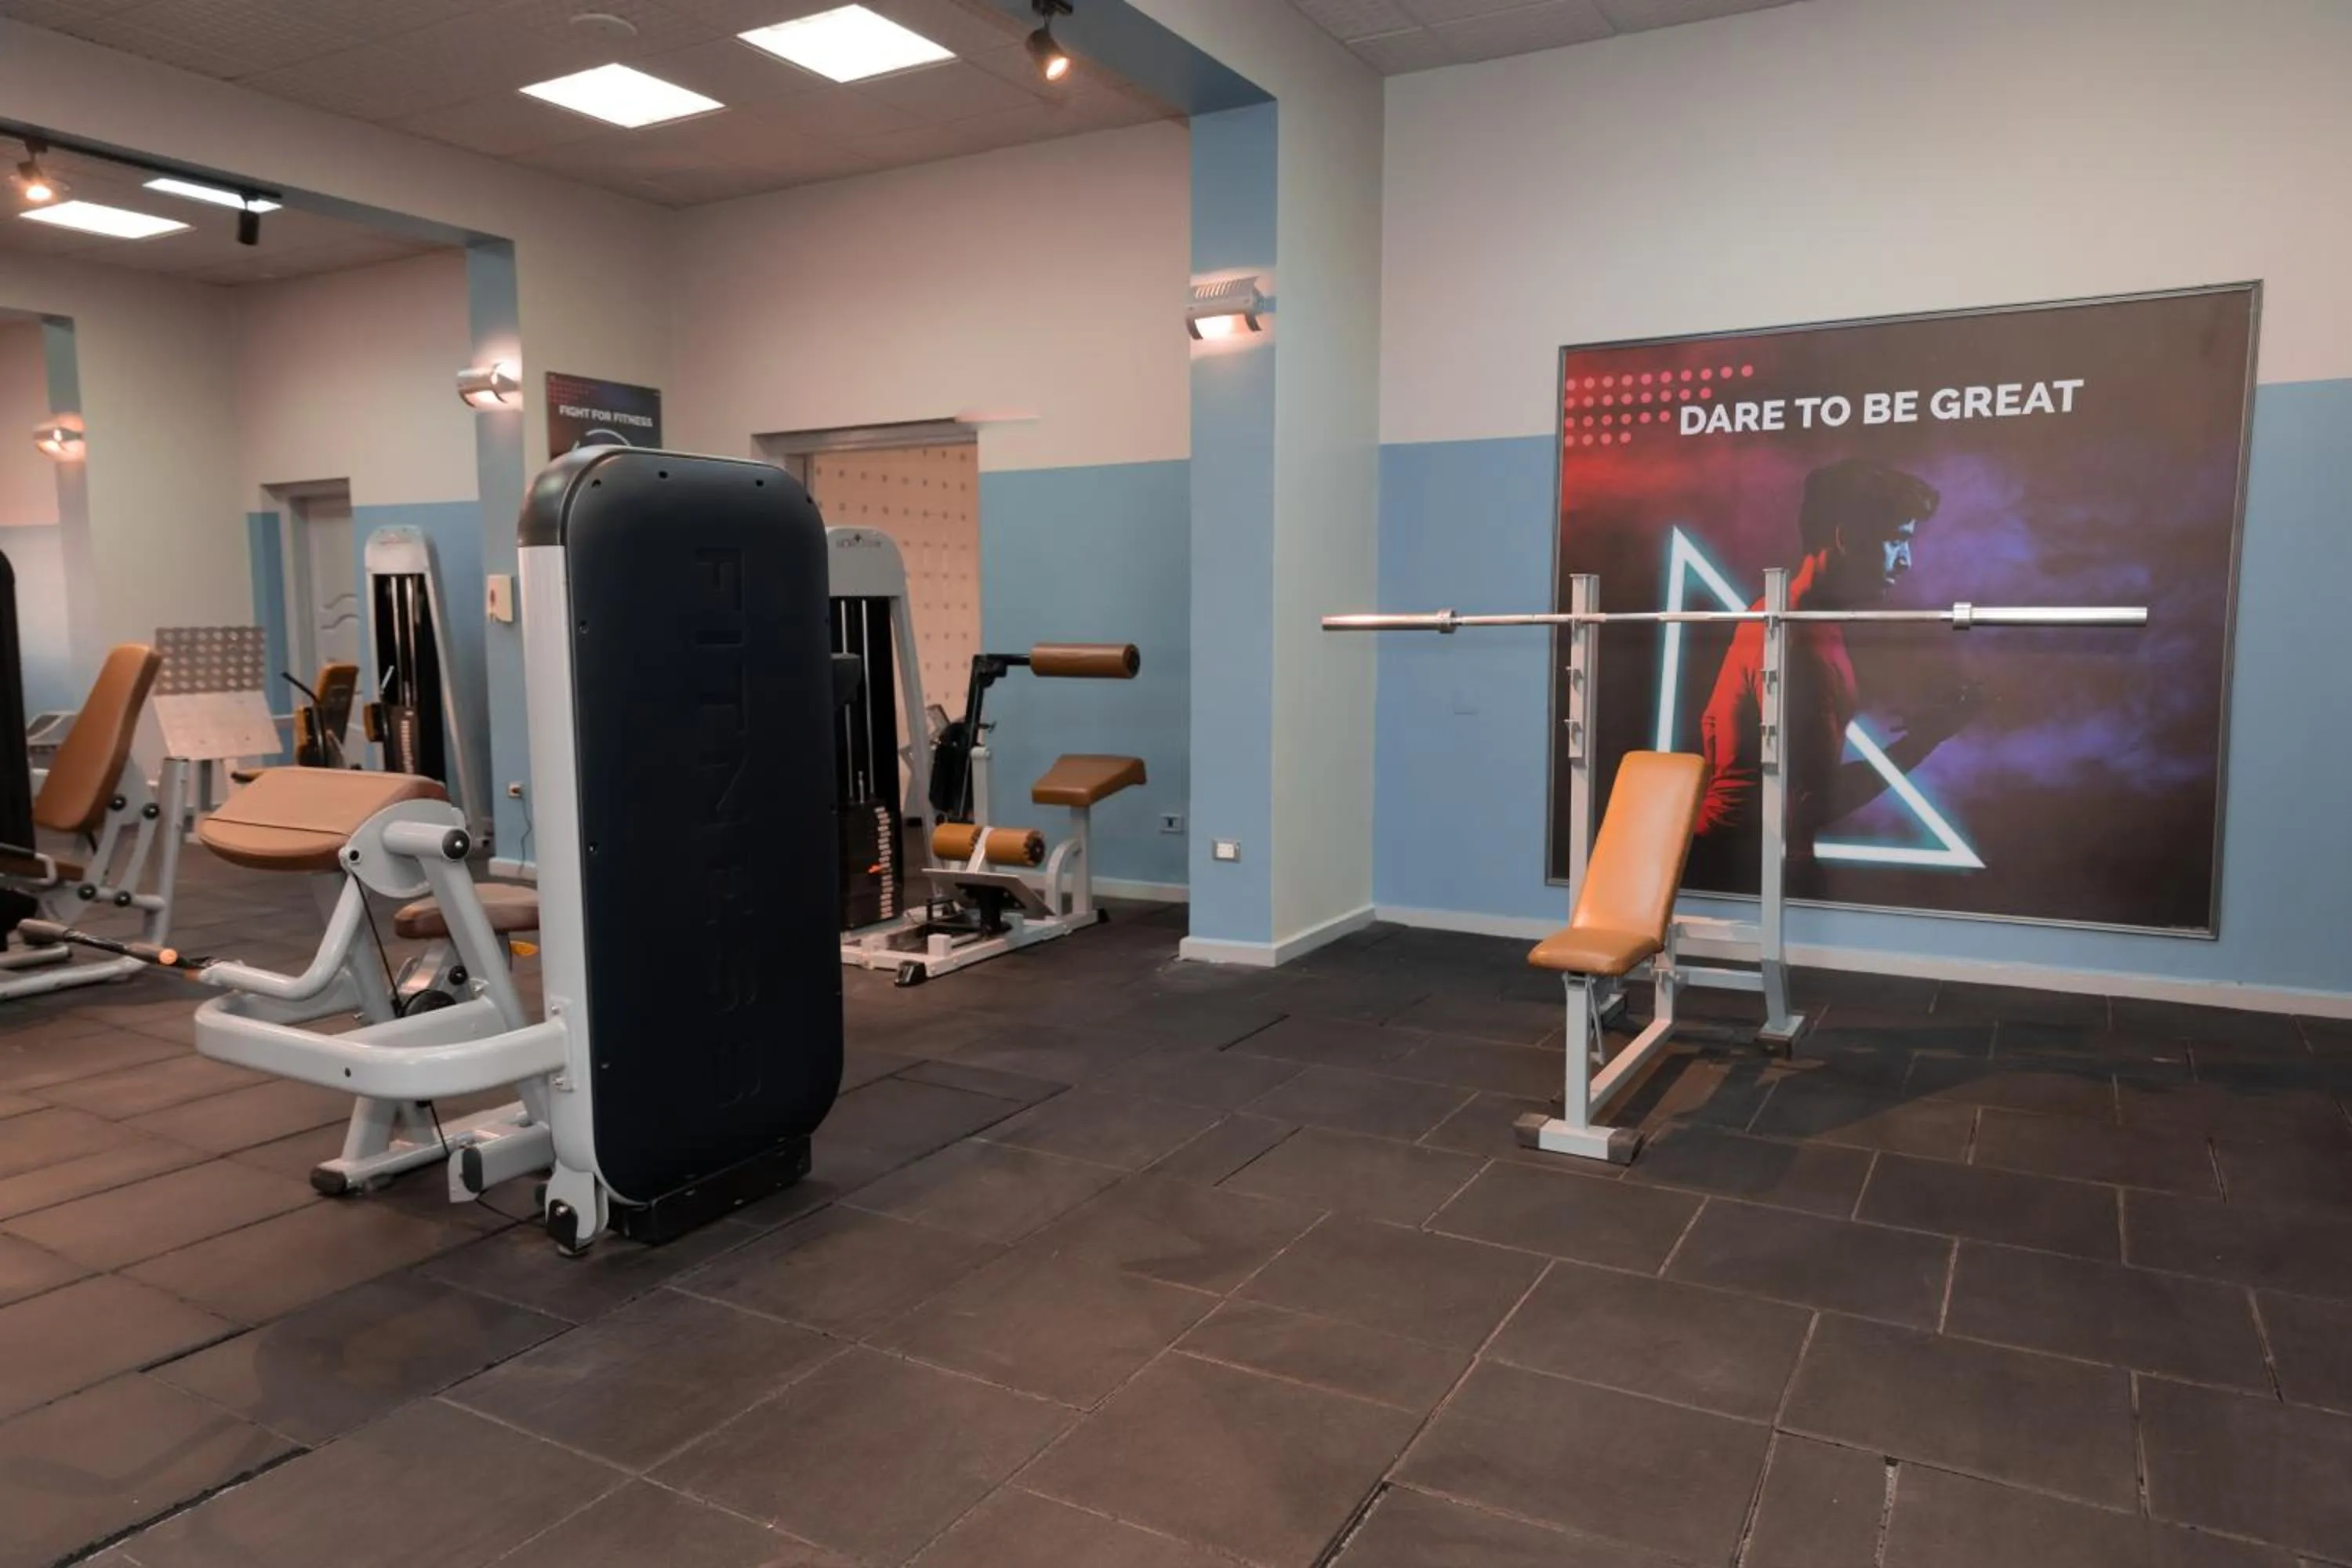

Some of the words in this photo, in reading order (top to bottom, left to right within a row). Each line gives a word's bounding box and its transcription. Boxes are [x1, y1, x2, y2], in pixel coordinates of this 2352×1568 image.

[559, 405, 590, 419] FIGHT
[591, 408, 612, 421] FOR
[613, 412, 653, 427] FITNESS
[1680, 400, 1785, 435] DARE
[1795, 395, 1851, 428] TO
[1864, 391, 1919, 425] BE
[1930, 379, 2085, 420] GREAT
